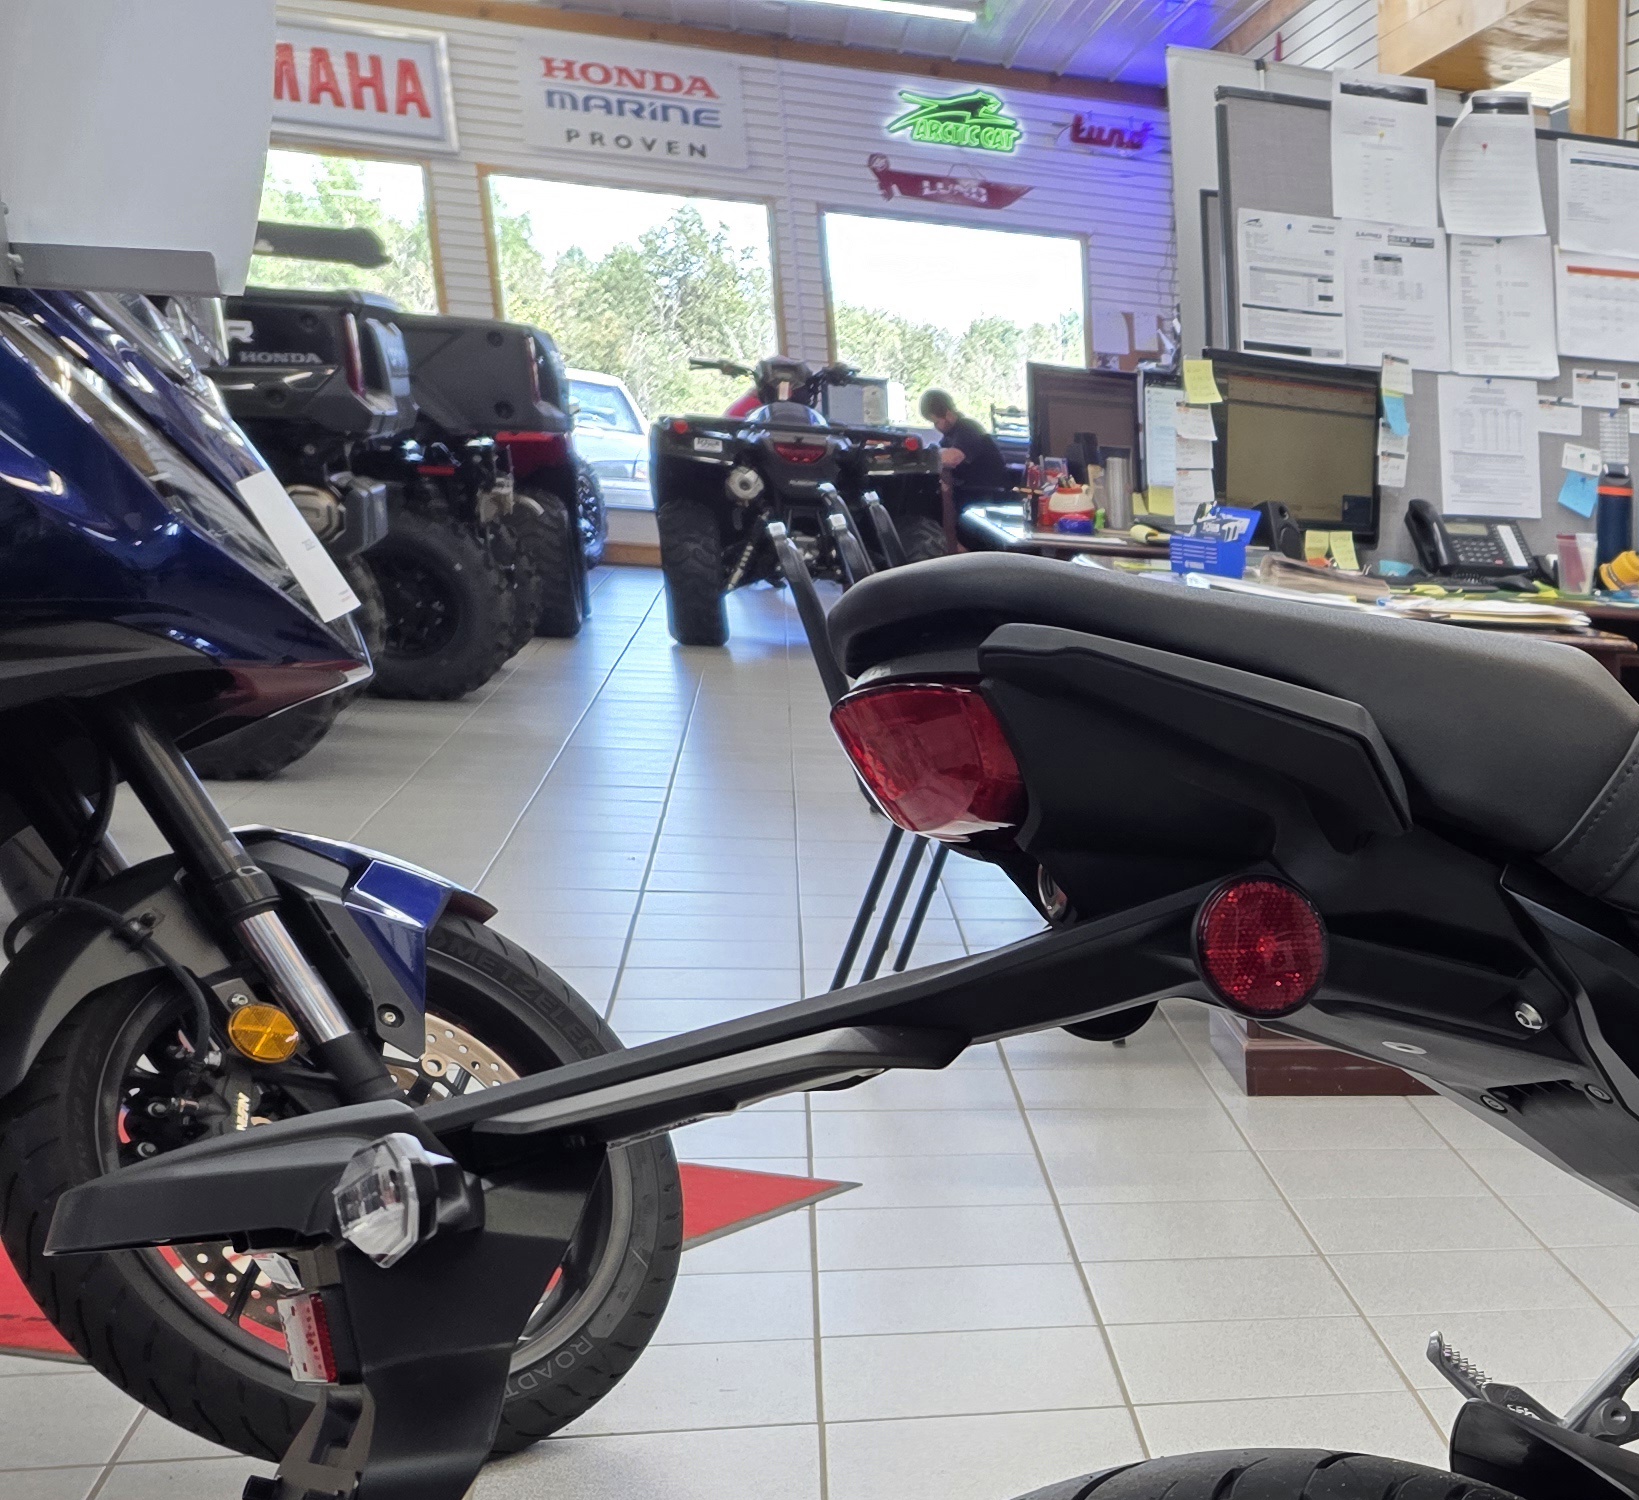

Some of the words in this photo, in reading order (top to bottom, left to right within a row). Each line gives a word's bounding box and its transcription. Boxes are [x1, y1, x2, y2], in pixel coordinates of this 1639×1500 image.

[540, 56, 720, 99] HONDA
[546, 89, 722, 128] MARINE
[566, 128, 708, 158] PROVEN
[912, 119, 980, 147] ARCTIC
[979, 126, 1020, 151] CAT
[239, 351, 323, 364] HONDA
